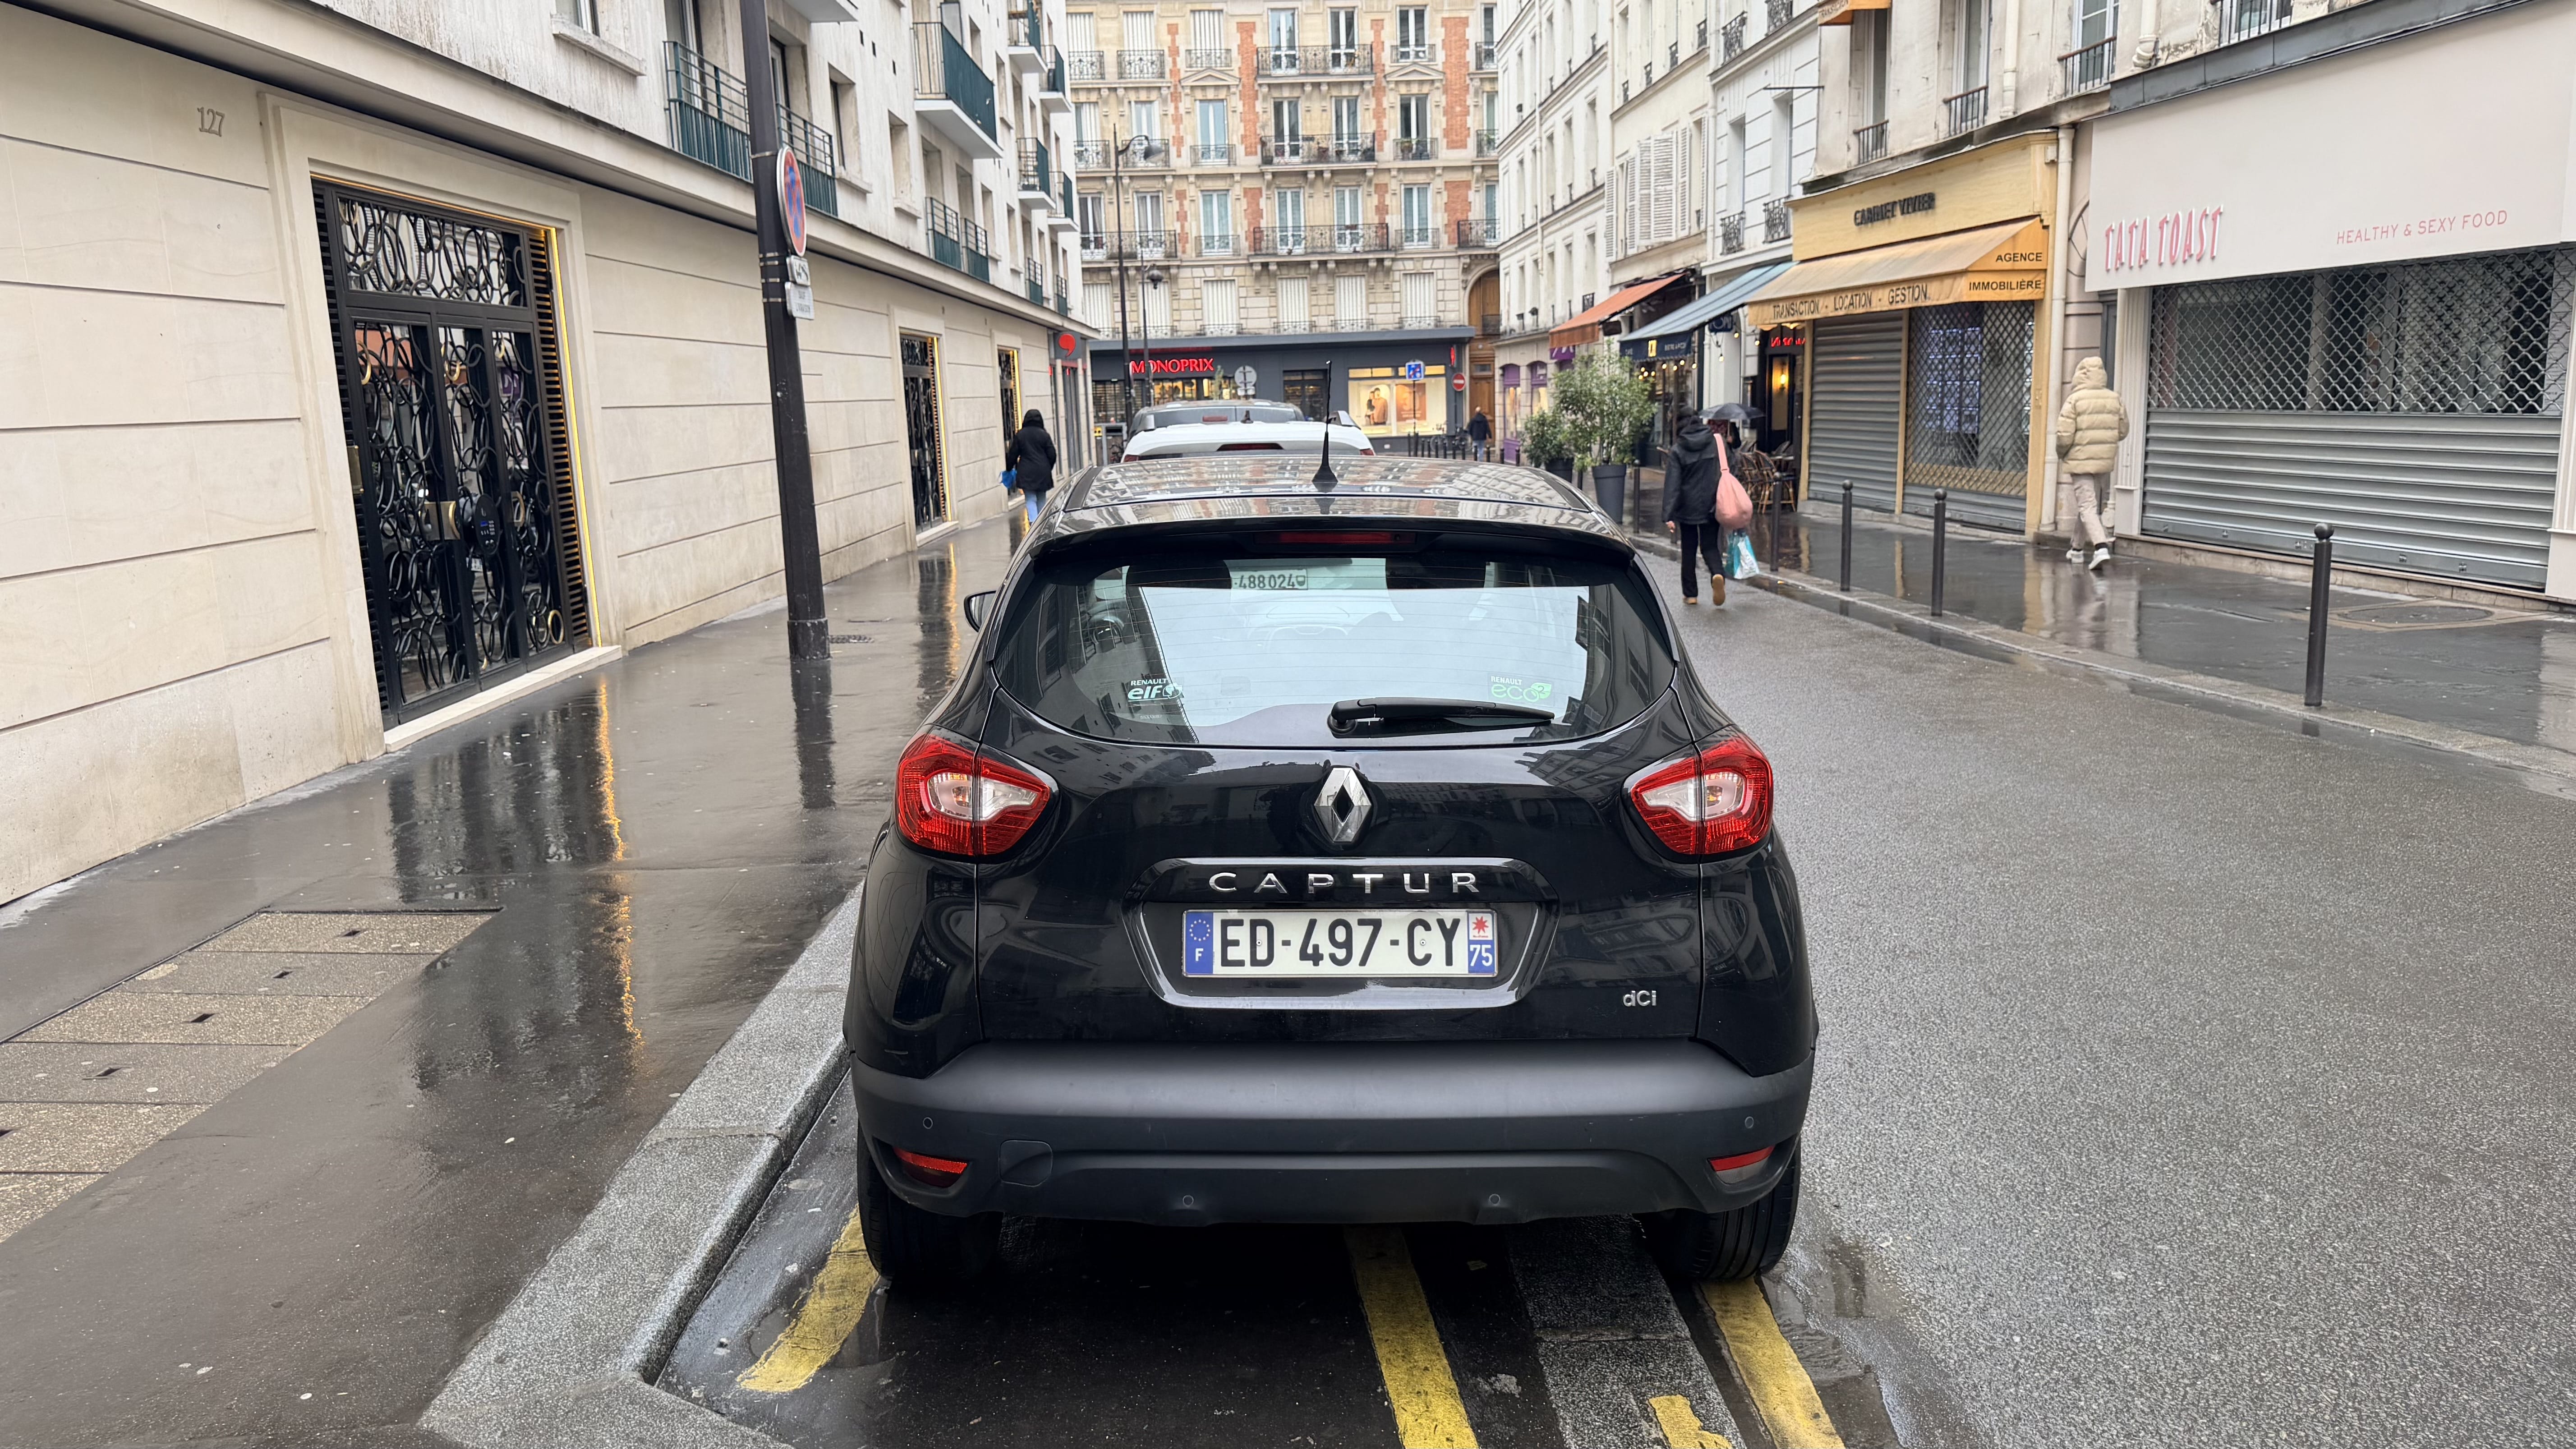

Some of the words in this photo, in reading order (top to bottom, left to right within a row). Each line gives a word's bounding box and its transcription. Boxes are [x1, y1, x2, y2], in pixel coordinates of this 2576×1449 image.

[197, 106, 225, 137] 127
[2337, 224, 2398, 244] HEALTHY
[2403, 224, 2412, 236] &
[2417, 216, 2456, 235] SEXY
[2462, 210, 2507, 229] FOOD
[2105, 215, 2150, 272] TATA
[2158, 204, 2224, 266] TOAST
[1995, 252, 2042, 262] AGENCE
[1969, 278, 2042, 291] IMMOBILIÈRE
[1772, 299, 1820, 320] TRANSACTION
[1834, 291, 1872, 311] LOCATION
[1888, 283, 1928, 305] GESTION
[1129, 358, 1214, 373] MONOPRIX
[1131, 678, 1169, 686] RENAULT
[1490, 676, 1523, 685] RENAULT
[1127, 685, 1163, 699] elf
[1209, 873, 1480, 894] CAPTUR
[1220, 918, 1461, 967] ED-497-CY
[1195, 948, 1203, 961] F
[1469, 944, 1493, 966] 75
[1623, 990, 1656, 1007] dCi
